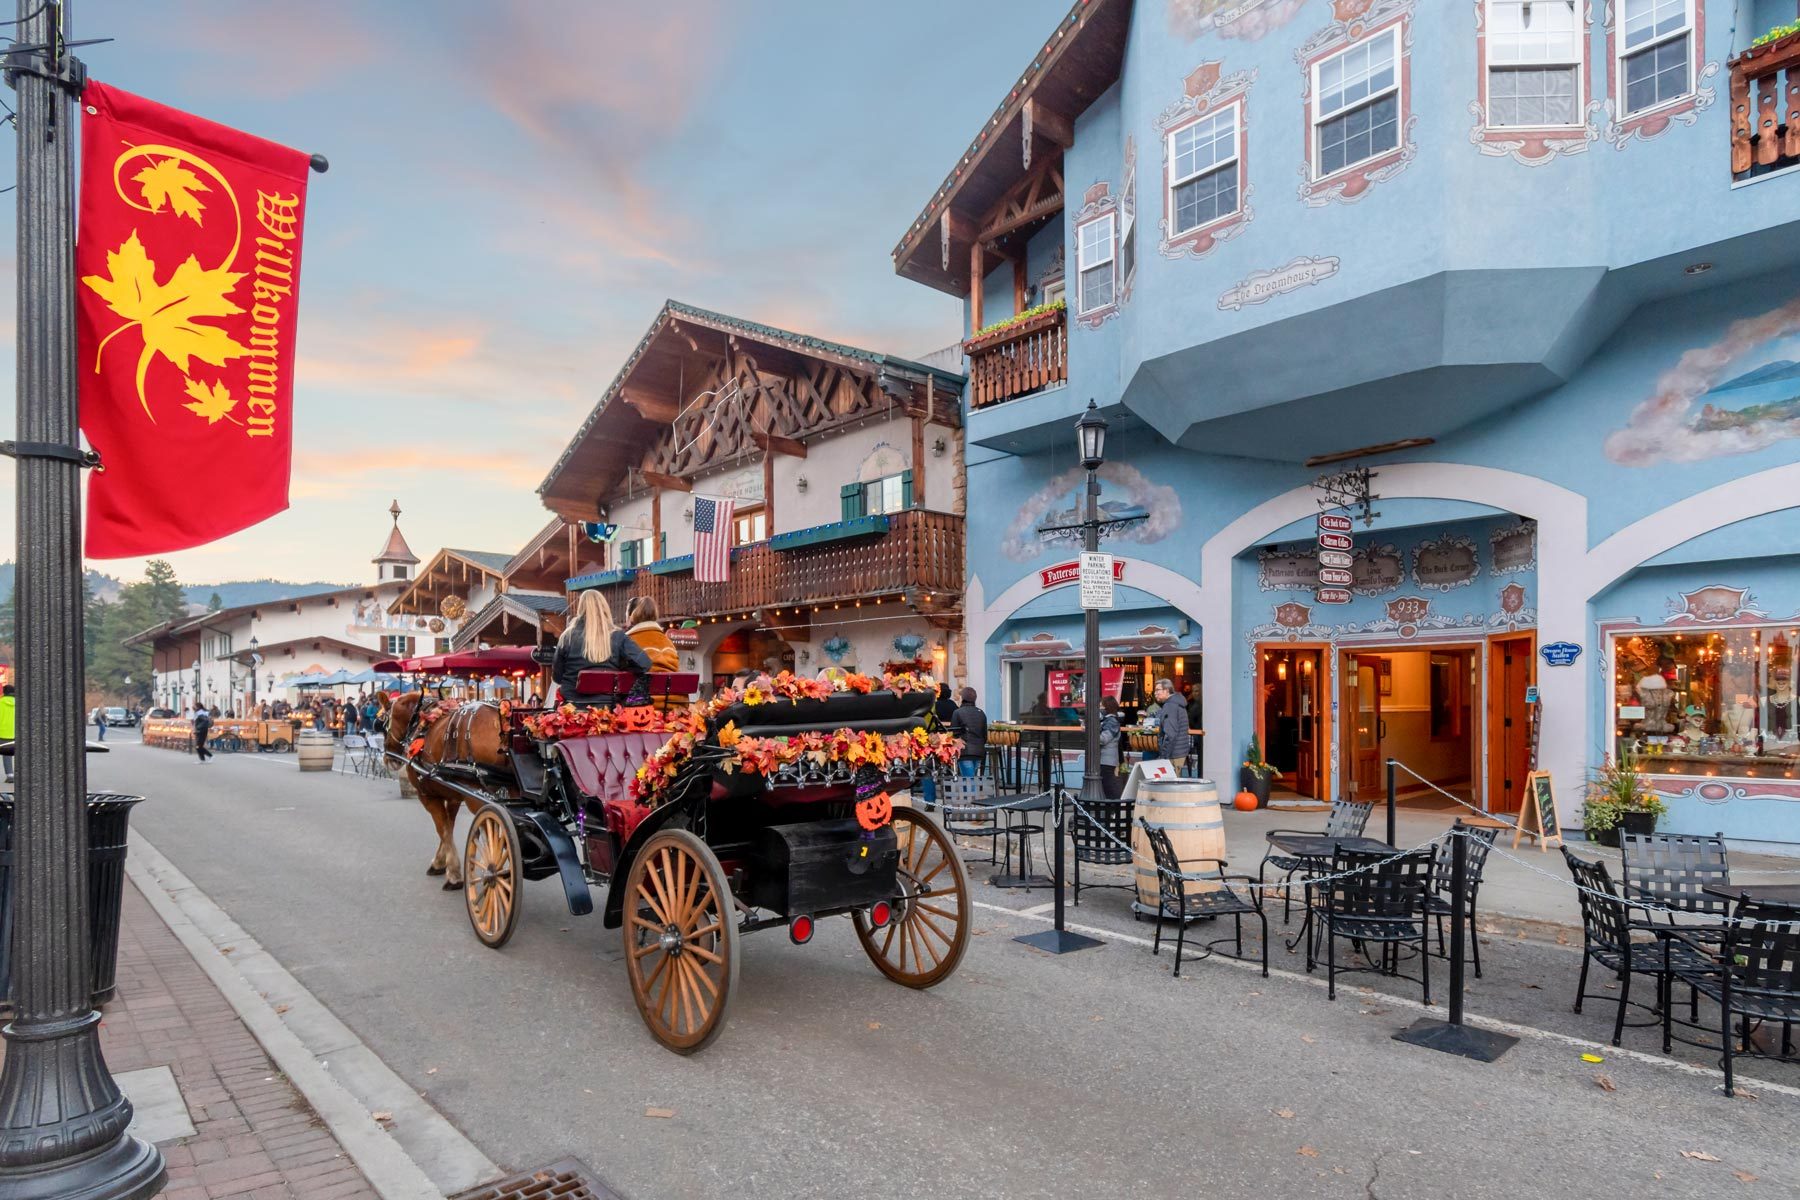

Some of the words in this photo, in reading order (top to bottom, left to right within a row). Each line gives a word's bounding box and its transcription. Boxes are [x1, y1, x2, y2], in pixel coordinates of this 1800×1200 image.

[1234, 290, 1250, 301] The
[1254, 268, 1317, 294] Dreamhouse
[246, 189, 299, 438] Willkommen
[1047, 567, 1080, 583] Patterson
[1421, 565, 1433, 575] The
[1398, 601, 1419, 613] 933
